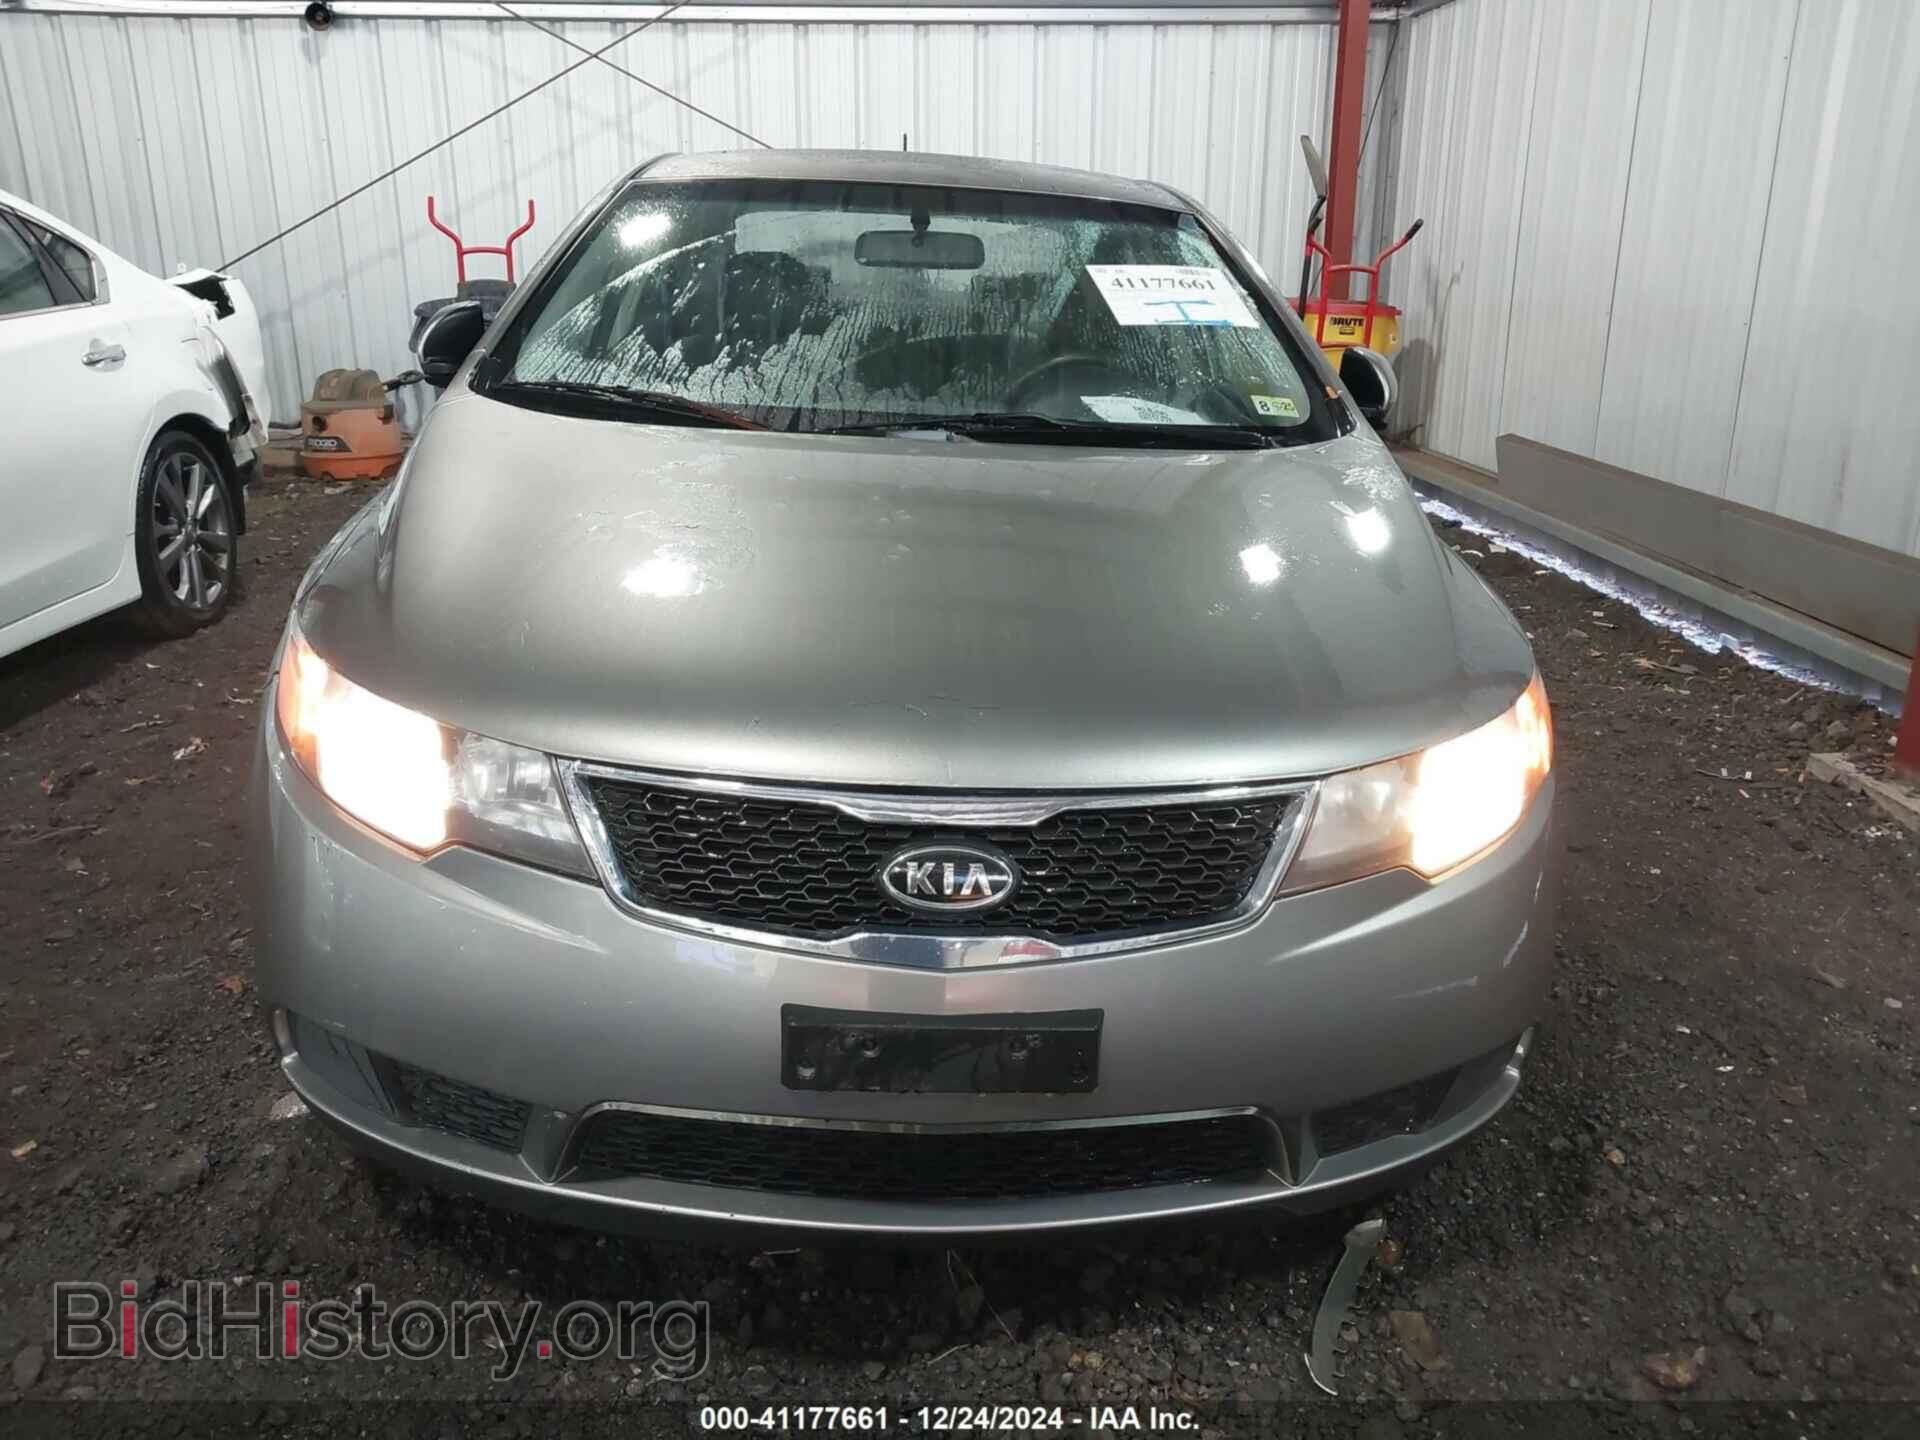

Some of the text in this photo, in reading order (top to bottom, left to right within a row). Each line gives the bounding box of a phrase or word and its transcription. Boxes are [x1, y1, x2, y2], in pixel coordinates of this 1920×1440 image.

[1111, 277, 1216, 291] 41177661
[1330, 316, 1364, 326] BRUTE
[1258, 400, 1270, 411] 8
[906, 861, 992, 896] KIA
